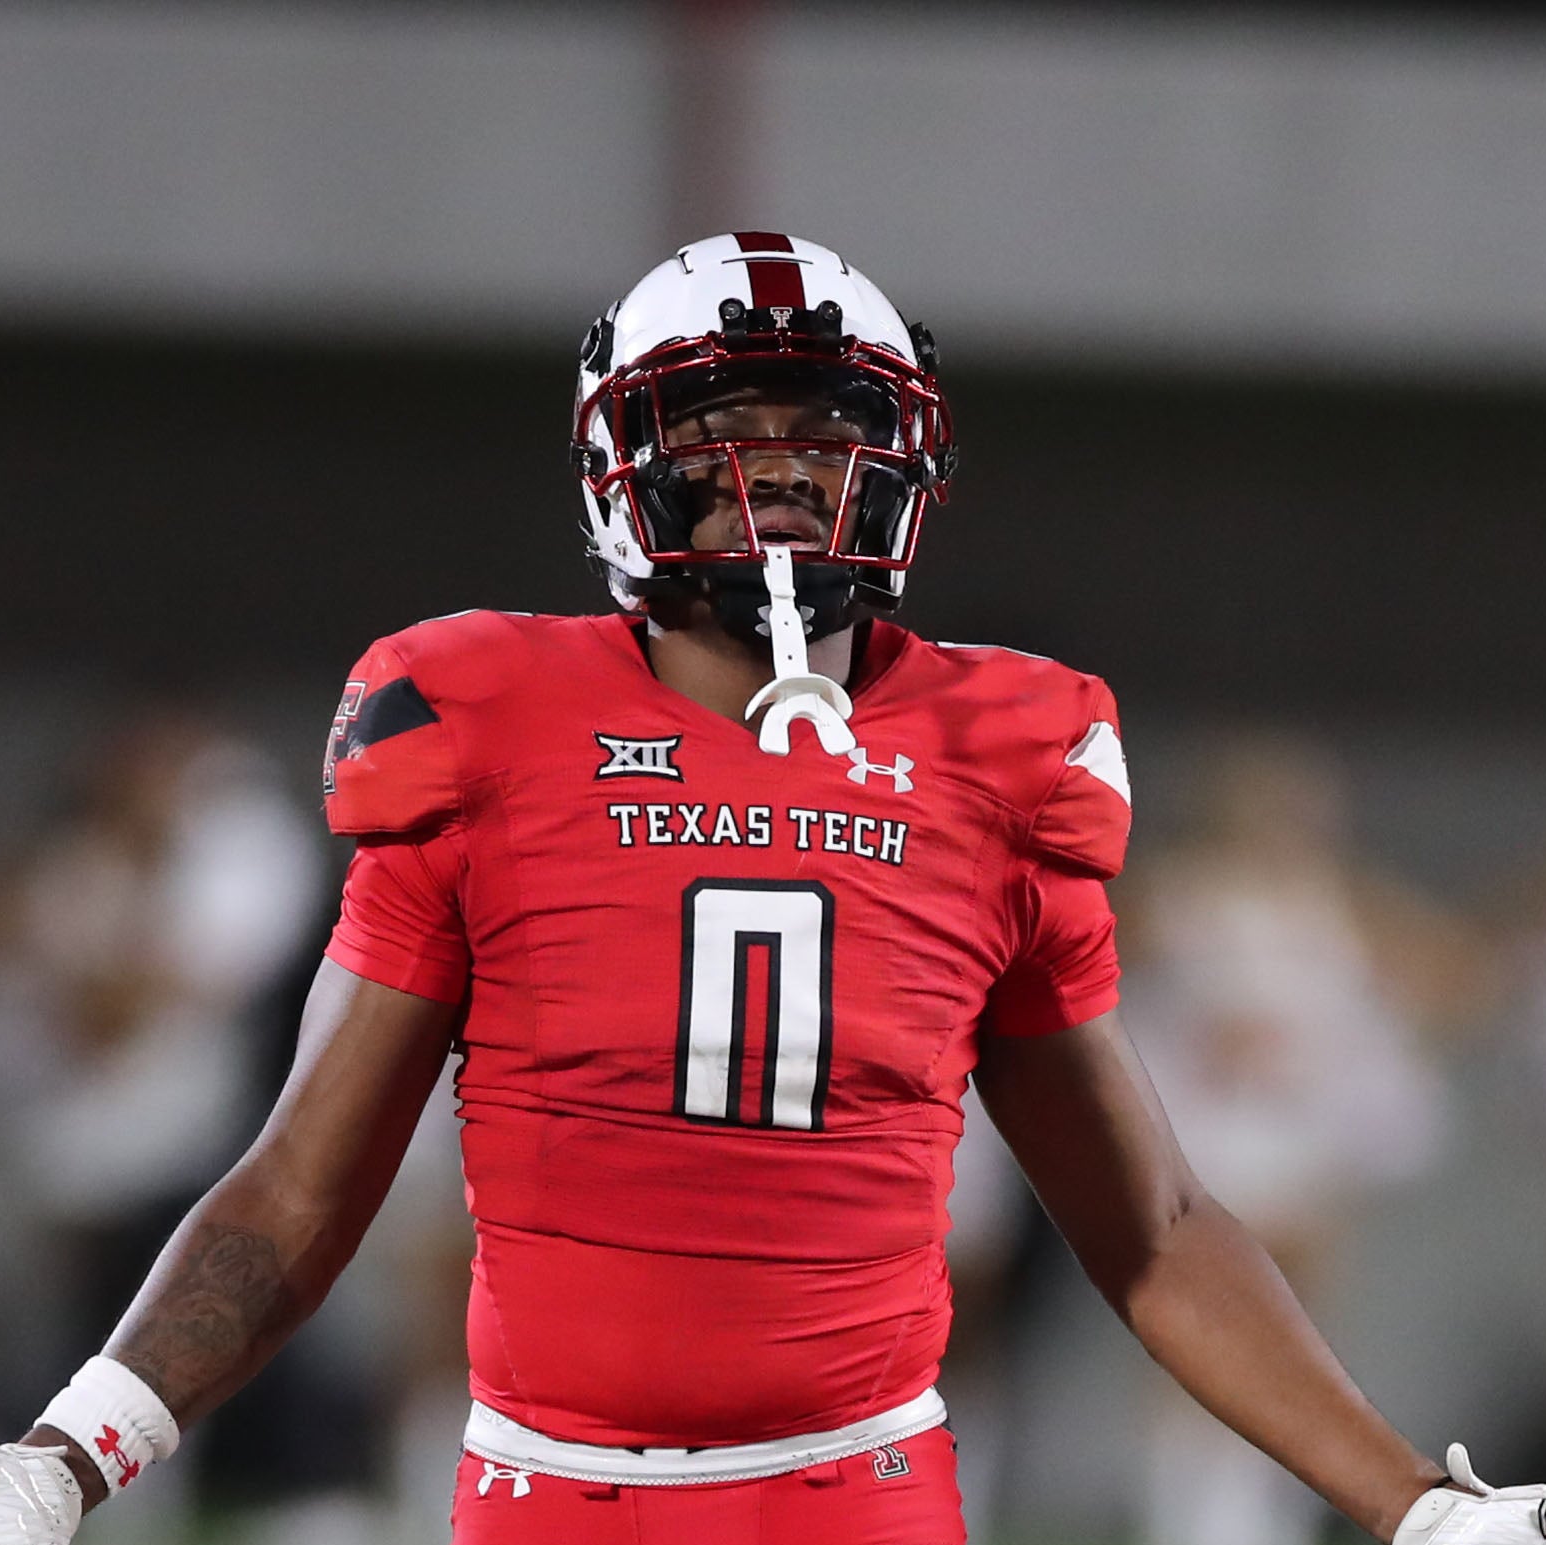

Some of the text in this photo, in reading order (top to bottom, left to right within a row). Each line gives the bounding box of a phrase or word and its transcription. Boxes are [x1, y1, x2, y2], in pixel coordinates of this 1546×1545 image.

[594, 731, 684, 782] XII
[608, 803, 908, 866] TEXAS TECH
[674, 877, 835, 1132] 0
